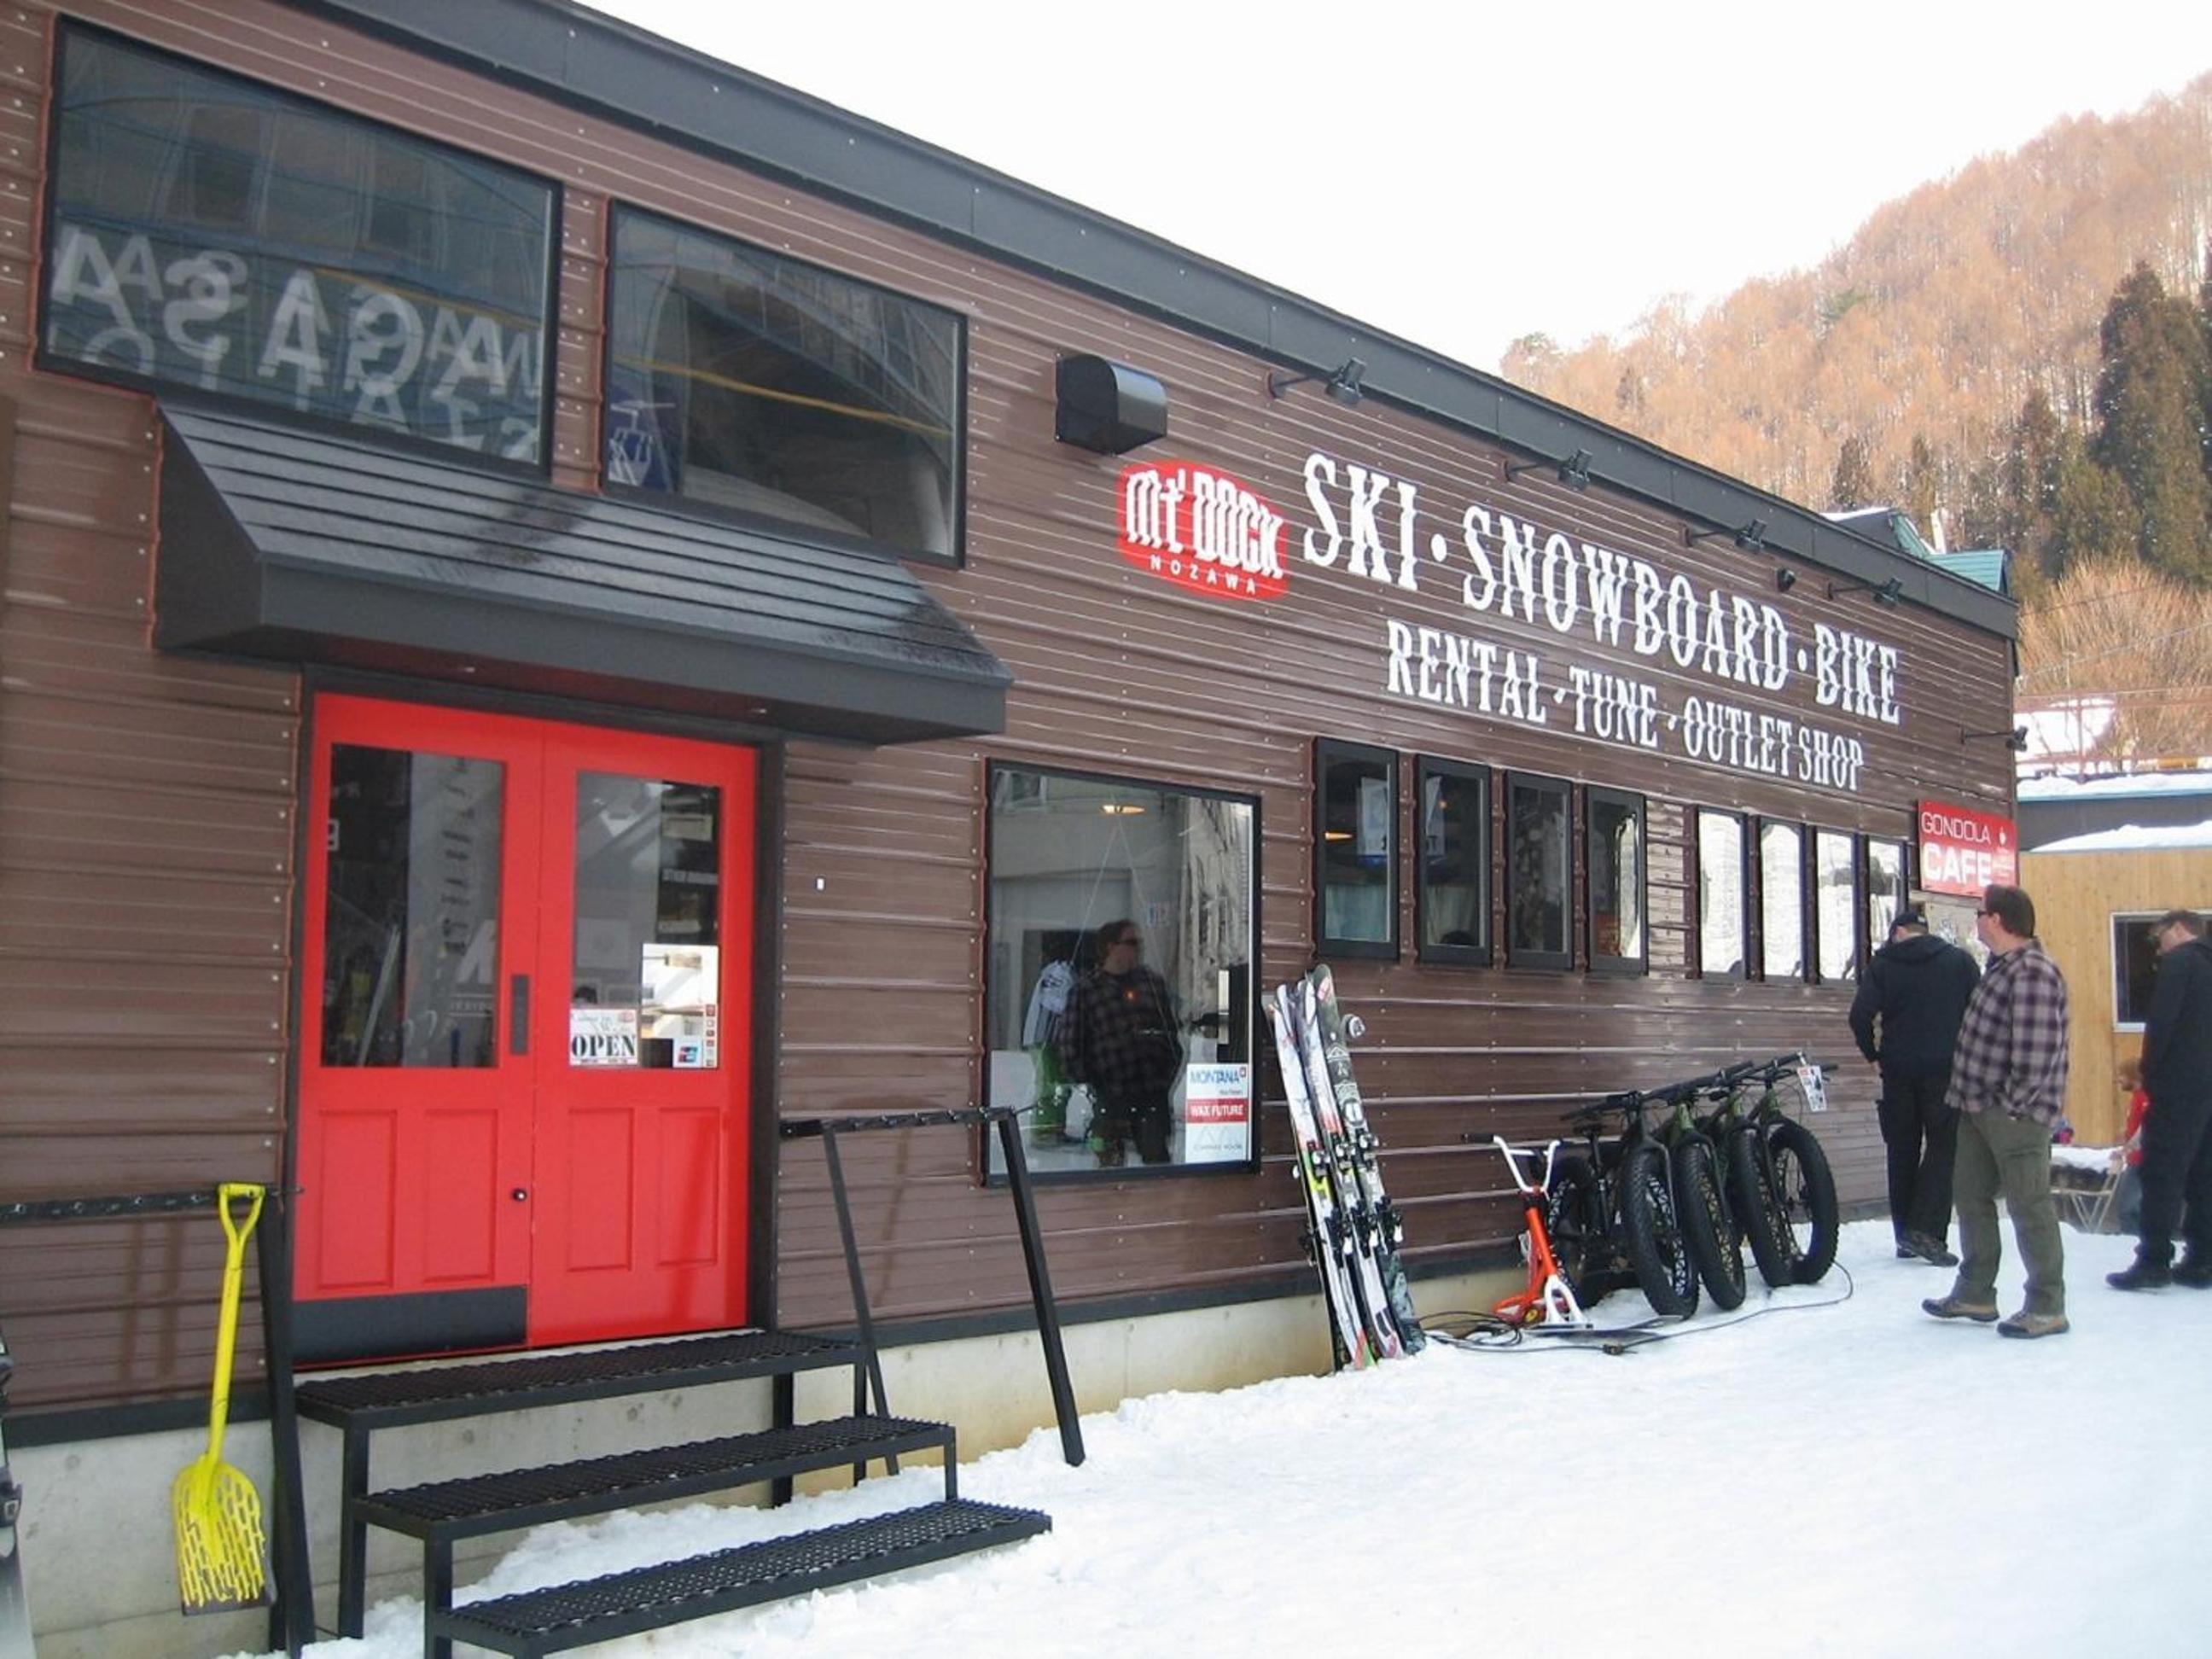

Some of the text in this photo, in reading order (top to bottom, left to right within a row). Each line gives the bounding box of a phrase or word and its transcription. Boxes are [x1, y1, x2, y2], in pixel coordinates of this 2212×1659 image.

[1192, 470, 1284, 580] DOCK
[1150, 553, 1257, 596] NOZAWA
[1303, 452, 1901, 725] SKI SNOWBOARD BIKE
[1387, 619, 1865, 791] RENTAL TUNE OUTLET SHOP
[1921, 812, 1991, 843] GONDOLA
[1922, 842, 1994, 887] CAFE
[571, 1034, 637, 1057] OPEN
[1190, 1068, 1241, 1086] MONTANA
[1212, 1104, 1244, 1117] FUTURE
